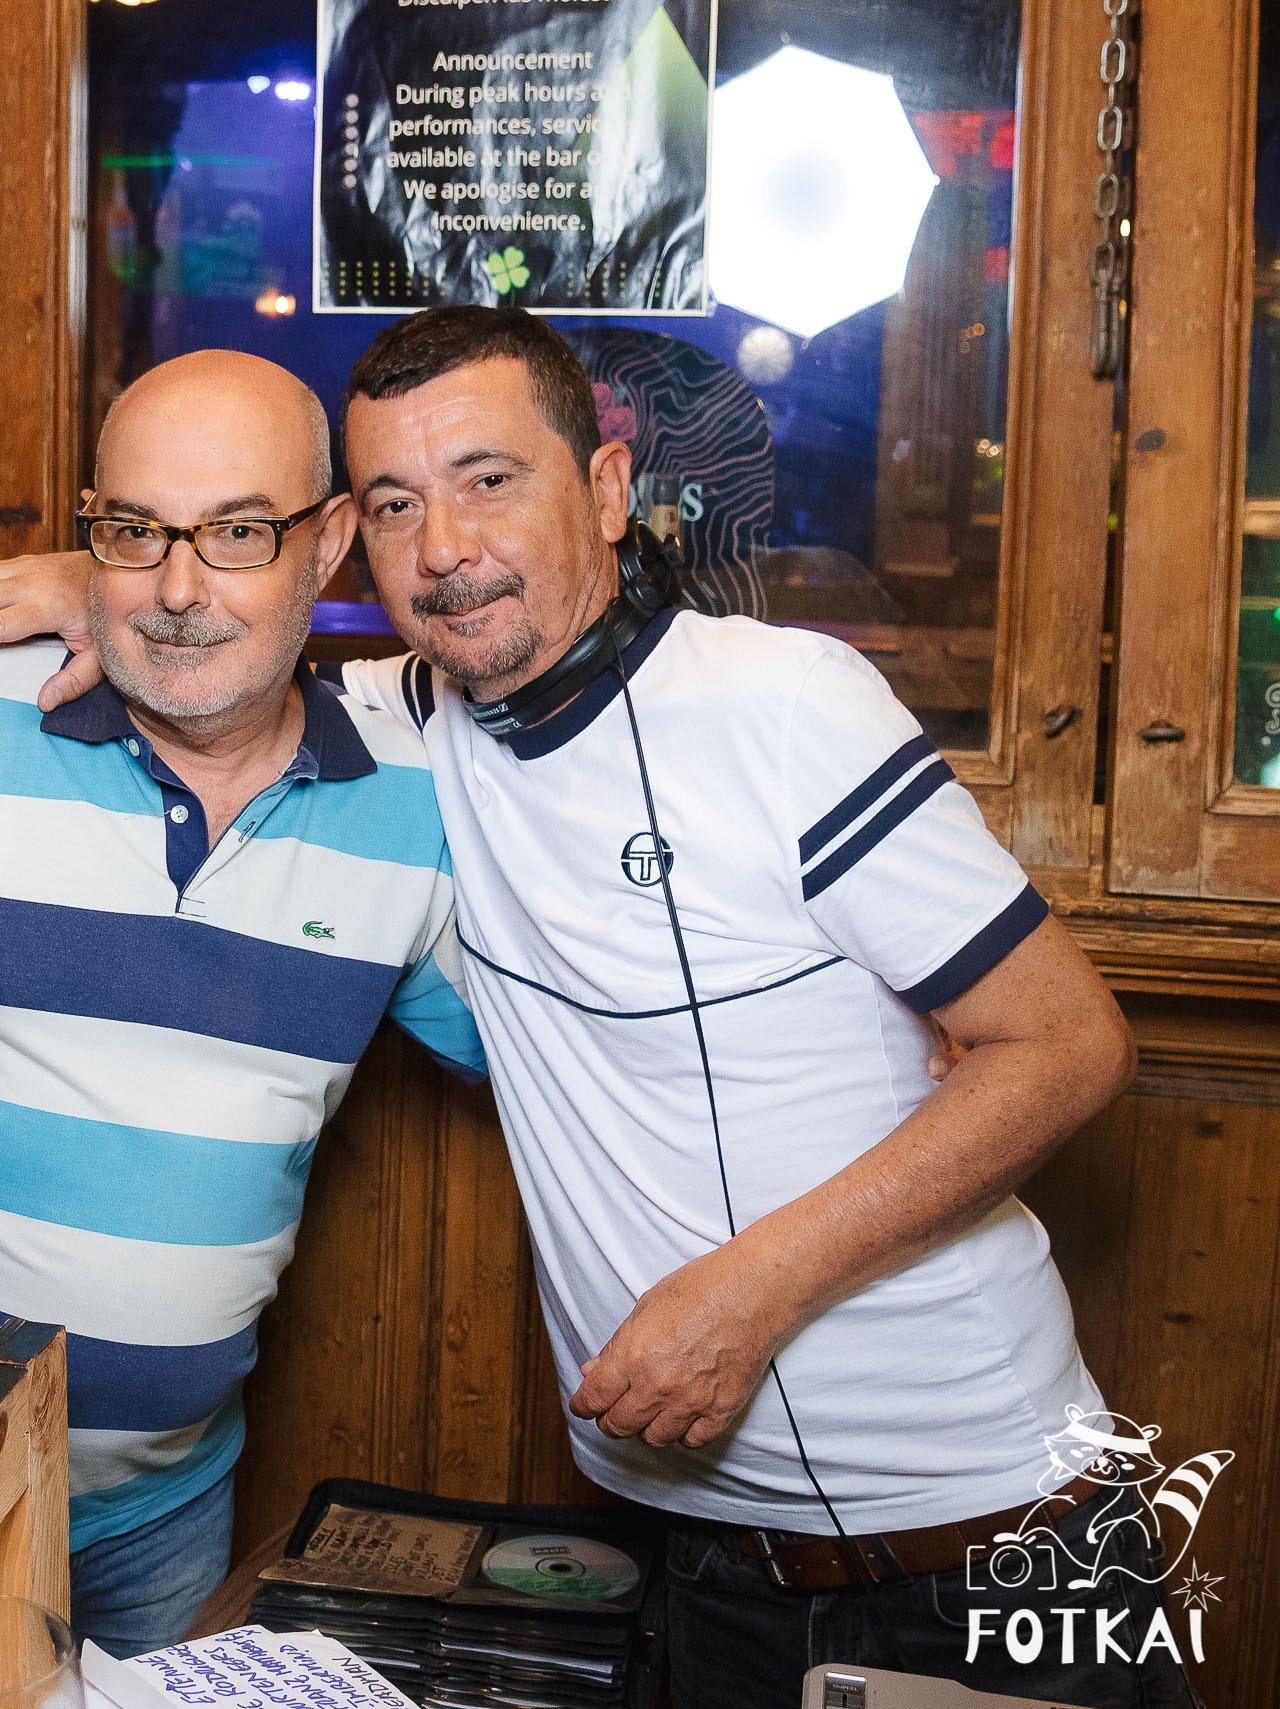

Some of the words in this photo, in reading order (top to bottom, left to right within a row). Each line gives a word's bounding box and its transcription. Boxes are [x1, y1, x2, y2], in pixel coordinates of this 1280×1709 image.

[432, 51, 593, 72] Announcement
[395, 83, 465, 108] During
[469, 81, 520, 108] peak
[524, 80, 586, 103] hours
[389, 114, 536, 142] performances,
[541, 113, 603, 135] servic
[387, 145, 476, 169] available
[480, 149, 503, 168] at
[506, 145, 542, 168] the
[546, 144, 582, 168] bar
[403, 179, 437, 200] We
[440, 179, 540, 206] apologise
[544, 176, 576, 200] for
[432, 211, 587, 232] inconvenience.
